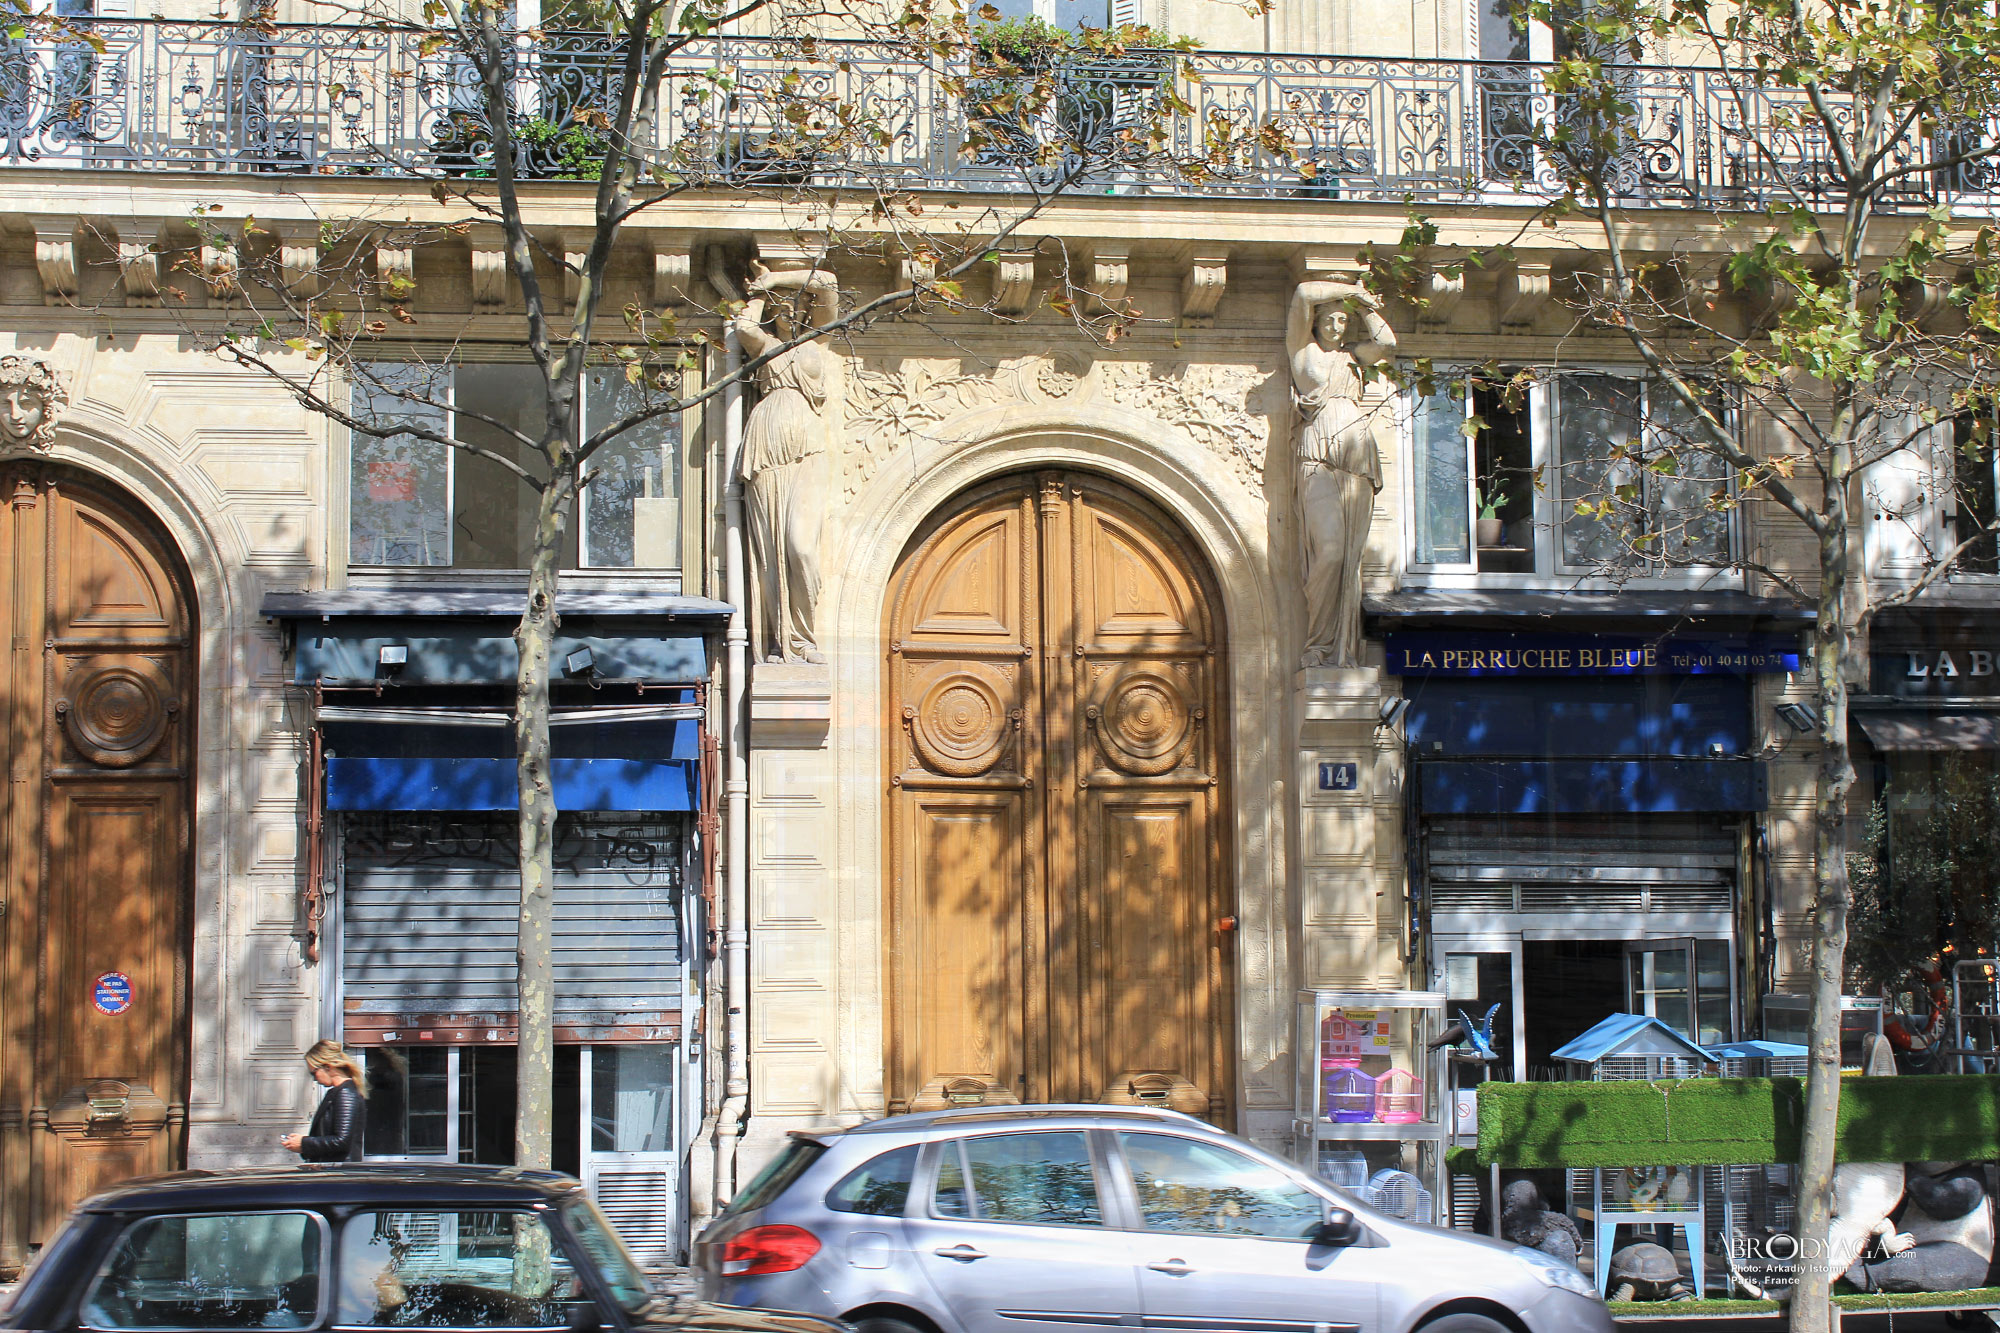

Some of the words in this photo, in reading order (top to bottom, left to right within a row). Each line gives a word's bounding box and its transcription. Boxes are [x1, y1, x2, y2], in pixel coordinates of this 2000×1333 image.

[1404, 649, 1437, 668] LA
[1442, 649, 1572, 669] PERRUCHE
[1578, 648, 1657, 668] BLEUE
[1671, 655, 1690, 667] Tél
[1700, 655, 1713, 667] 01
[1717, 655, 1731, 667] 40
[1734, 655, 1748, 667] 41
[1751, 655, 1765, 667] 03
[1769, 654, 1782, 666] 74
[1906, 650, 1959, 677] LA
[1968, 650, 2000, 677] B
[1326, 766, 1349, 787] 14
